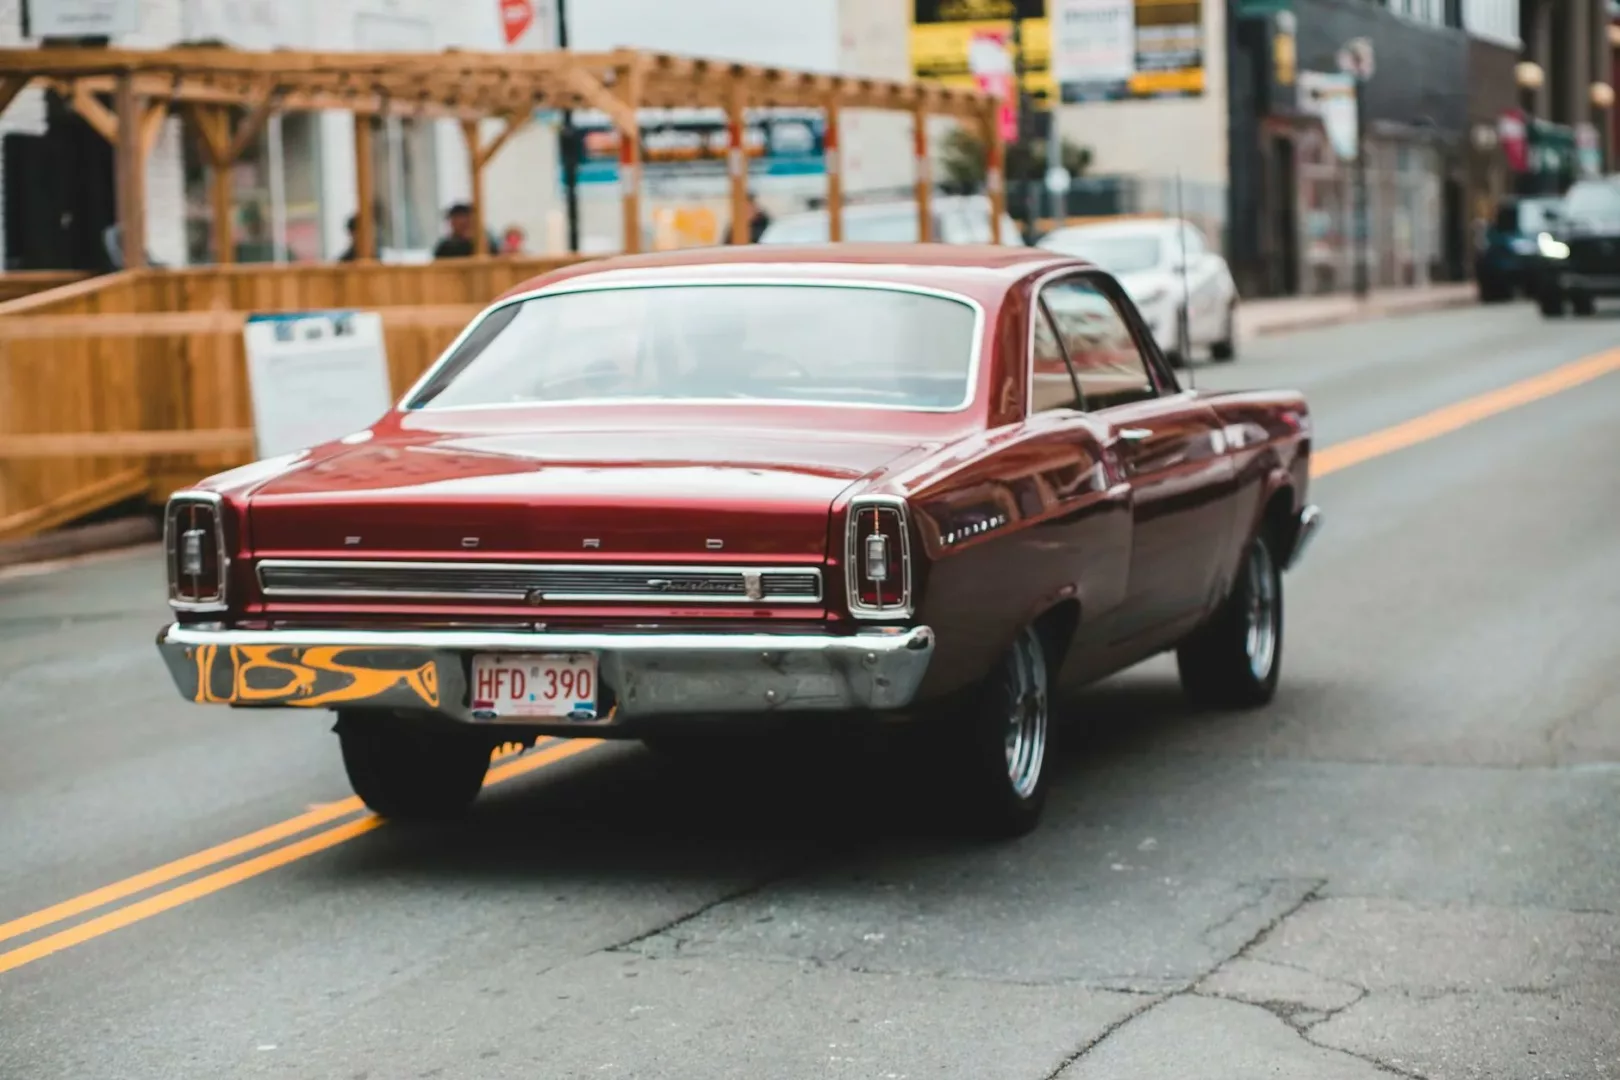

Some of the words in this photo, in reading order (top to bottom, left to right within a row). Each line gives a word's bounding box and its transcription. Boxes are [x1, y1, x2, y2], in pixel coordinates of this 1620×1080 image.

[344, 535, 724, 549] FORD
[478, 668, 526, 700] HFD
[543, 668, 592, 700] 390
